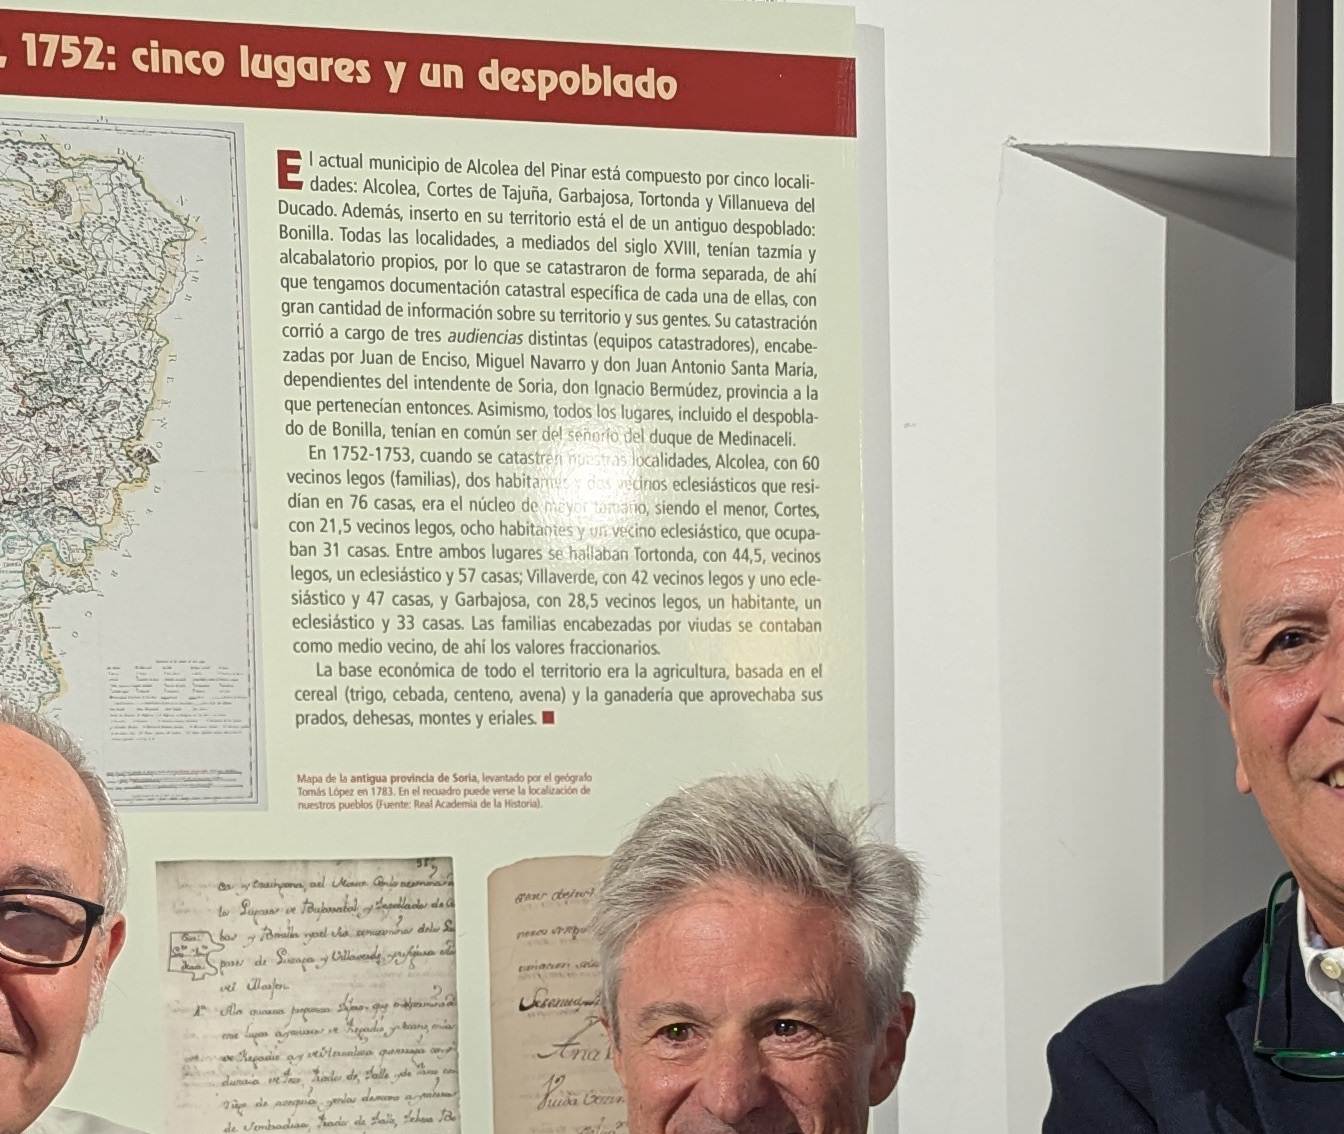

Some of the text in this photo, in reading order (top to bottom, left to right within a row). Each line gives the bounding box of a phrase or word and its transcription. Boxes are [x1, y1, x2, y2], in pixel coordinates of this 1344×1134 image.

[21, 32, 116, 70] 1752:
[131, 39, 224, 76] cinco
[239, 44, 371, 87] lugares
[383, 60, 406, 93] y
[419, 62, 463, 89] un
[478, 58, 677, 101] despoblado
[318, 152, 362, 169] actual
[369, 155, 439, 175] municipio
[444, 157, 462, 173] de
[466, 158, 518, 176] Alcolea
[524, 160, 544, 177] del
[550, 162, 586, 179] Pinar
[591, 164, 620, 180] está
[625, 169, 701, 186] compuesto
[706, 173, 729, 188] por
[733, 171, 769, 187] cinco
[774, 172, 815, 189] locali-
[309, 175, 814, 212] dades: Alcolea, Cortes de Tajuña, Garbajosa, Tortonda y Villanueva del
[291, 589, 821, 612] siástico y 47 casas, y Garbajosa, con 28,5 vecinos legos, un habitante, un
[294, 685, 823, 705] cereal (trigo, cebada, centeno, avena) y la ganadería que aprovechaba sus
[295, 709, 536, 729] prados, dehesas, montes y eriales.
[296, 771, 592, 785] Mapa de la antigua provincia de Soria, levantado por el geógrafo
[297, 786, 326, 796] Tomás
[328, 786, 354, 798] López
[356, 788, 368, 796] en
[371, 786, 395, 796] 1783.
[398, 786, 409, 796] En
[411, 785, 420, 796] el
[422, 785, 461, 796] recuadro
[463, 785, 490, 798] puede
[517, 785, 526, 795] la
[528, 785, 578, 795] localización
[580, 784, 590, 794] de
[297, 798, 542, 811] nuestros pueblos (Fuente: Real Academia de la Historia).
